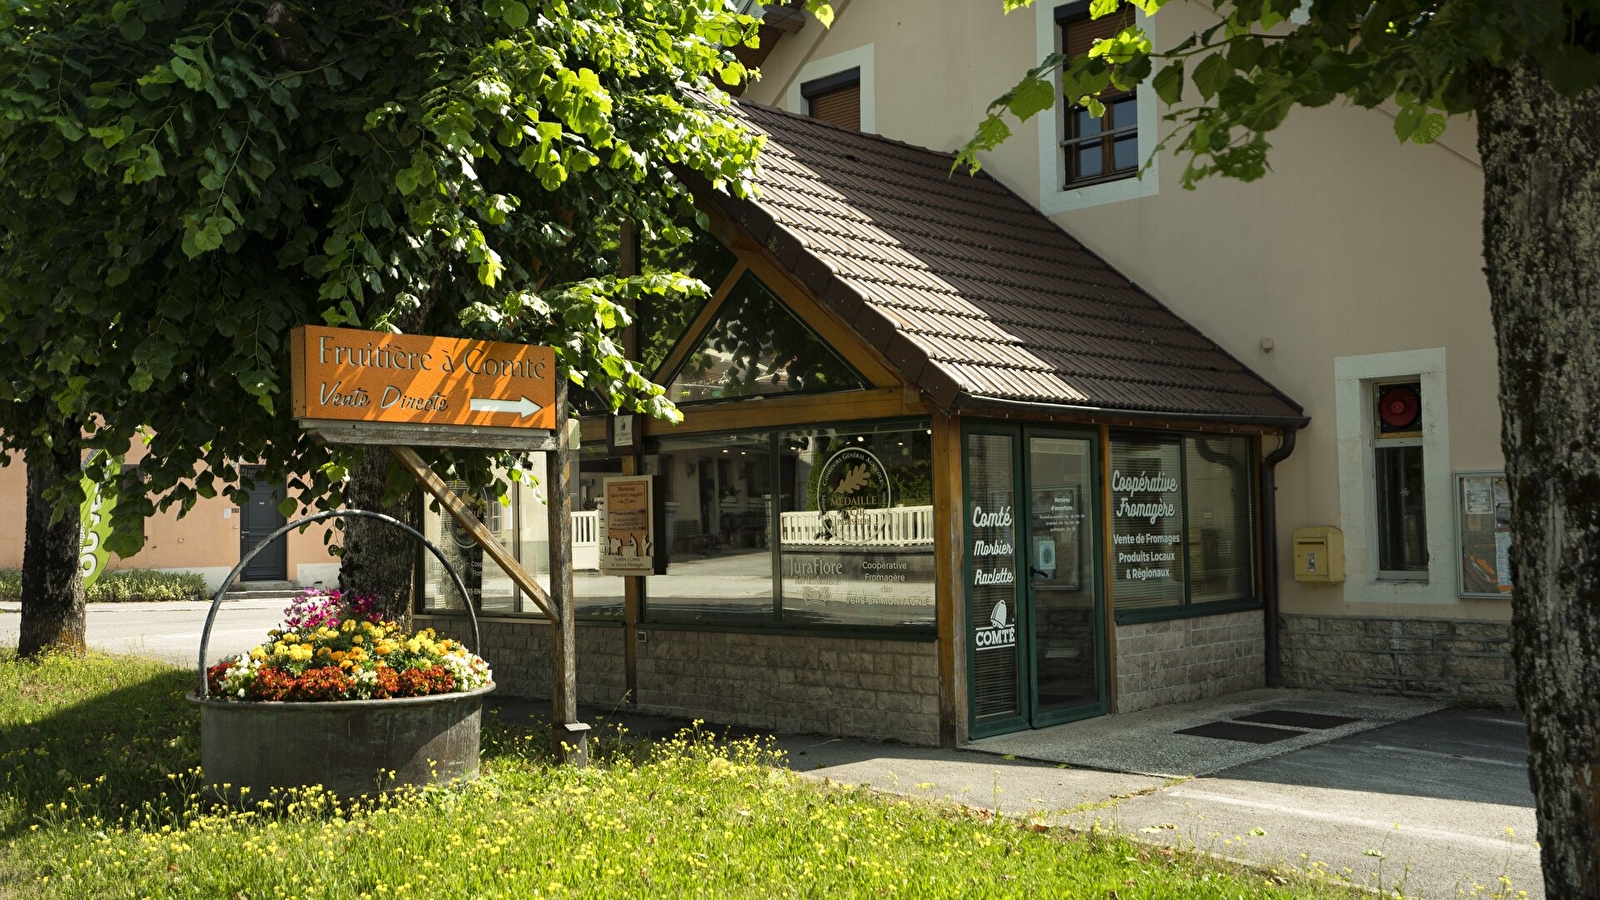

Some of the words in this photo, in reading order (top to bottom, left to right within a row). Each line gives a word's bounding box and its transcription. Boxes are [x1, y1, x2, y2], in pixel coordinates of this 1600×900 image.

[319, 335, 432, 371] Fruitière
[440, 349, 457, 373] à
[463, 348, 546, 380] Comté
[319, 381, 371, 408] Vente
[380, 384, 449, 413] Directe
[1111, 469, 1178, 498] Coopérative
[972, 505, 1013, 527] Comté
[1116, 497, 1175, 525] Fromagère
[973, 539, 1014, 557] Morbier
[1113, 533, 1134, 545] Vente
[1135, 533, 1146, 544] de
[1145, 533, 1180, 546] Fromages
[861, 560, 908, 571] Coopérative
[1118, 550, 1151, 563] Produits
[1150, 551, 1176, 562] Locaux
[788, 556, 843, 577] JuraFlore
[1126, 569, 1132, 579] &
[1132, 566, 1170, 581] Régionaux
[864, 572, 906, 583] Fromagère
[974, 567, 1014, 586] Raclette
[975, 627, 1016, 647] COMTÉ
